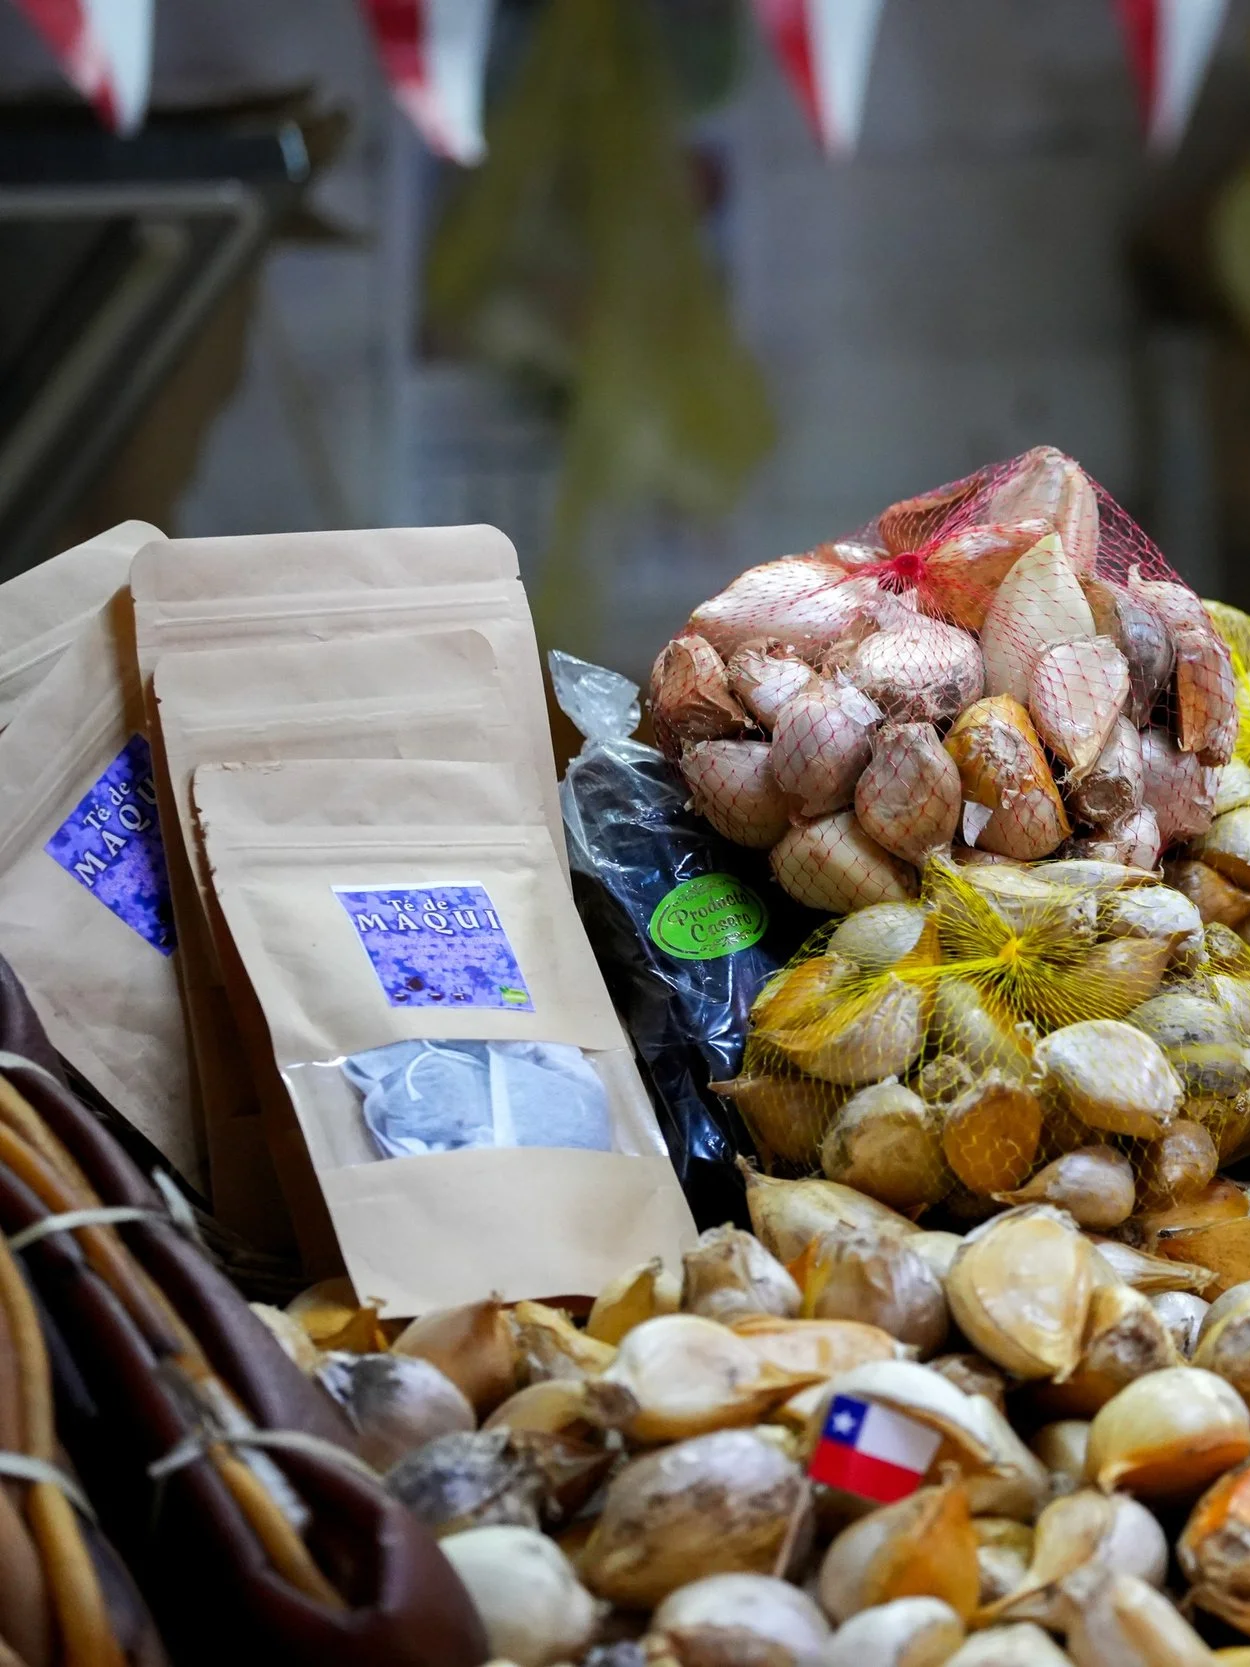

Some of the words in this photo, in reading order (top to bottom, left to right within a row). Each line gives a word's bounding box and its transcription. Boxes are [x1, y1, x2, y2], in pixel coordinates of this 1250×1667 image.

[83, 804, 111, 831] Té
[109, 783, 130, 806] de
[387, 899, 416, 911] Té
[424, 898, 449, 911] de
[667, 889, 748, 926] Producto
[355, 909, 501, 935] MAQUI
[690, 912, 752, 942] Casero
